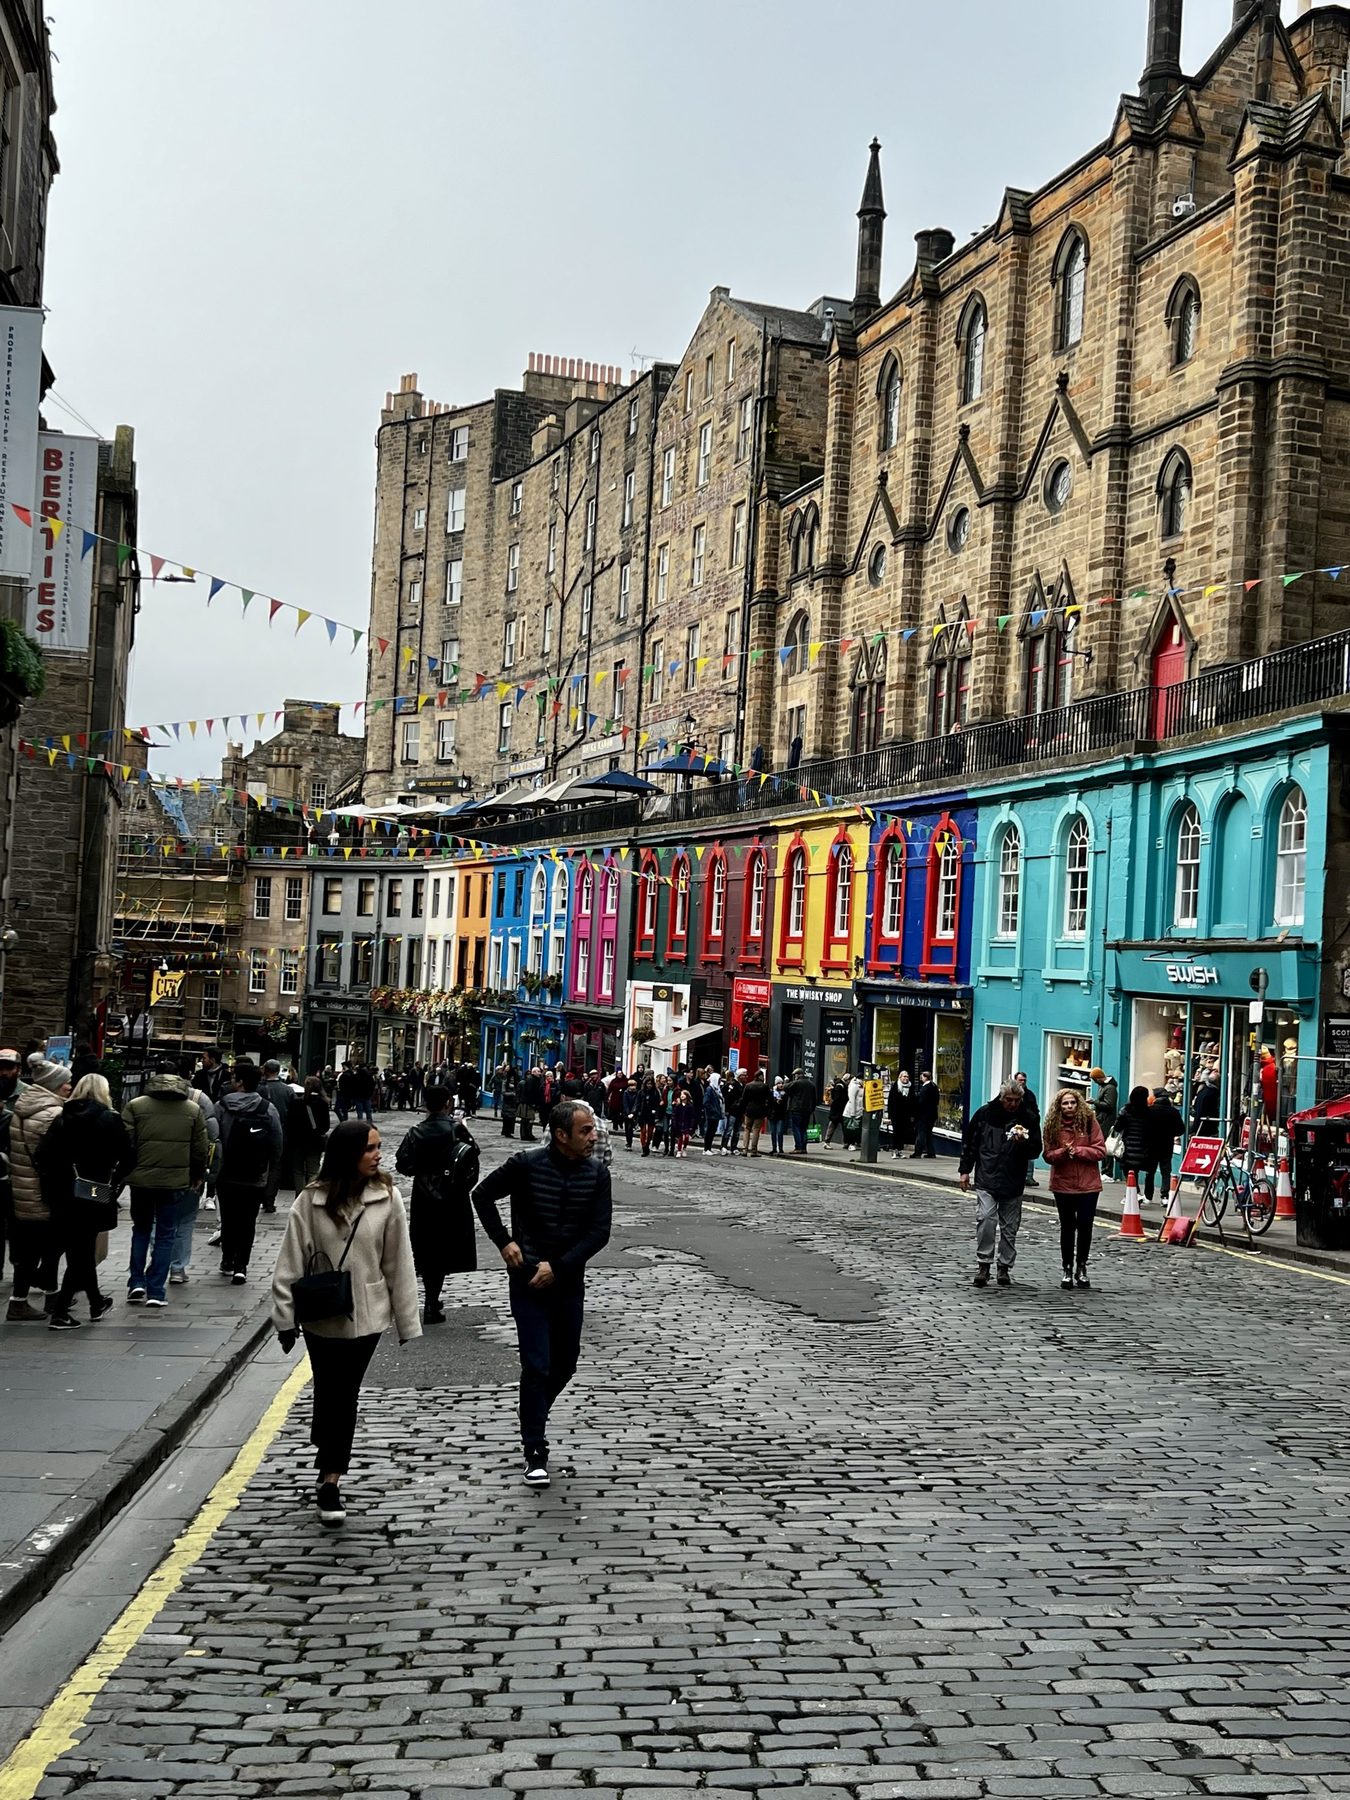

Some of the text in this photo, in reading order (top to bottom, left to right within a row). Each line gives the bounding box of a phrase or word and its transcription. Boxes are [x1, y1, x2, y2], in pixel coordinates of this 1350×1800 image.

[36, 448, 63, 632] BERTIES
[62, 553, 70, 608] RESTAURANT
[1166, 965, 1218, 984] SWISH
[156, 978, 182, 997] CITY
[786, 988, 842, 1003] THE WHISKY SHOP
